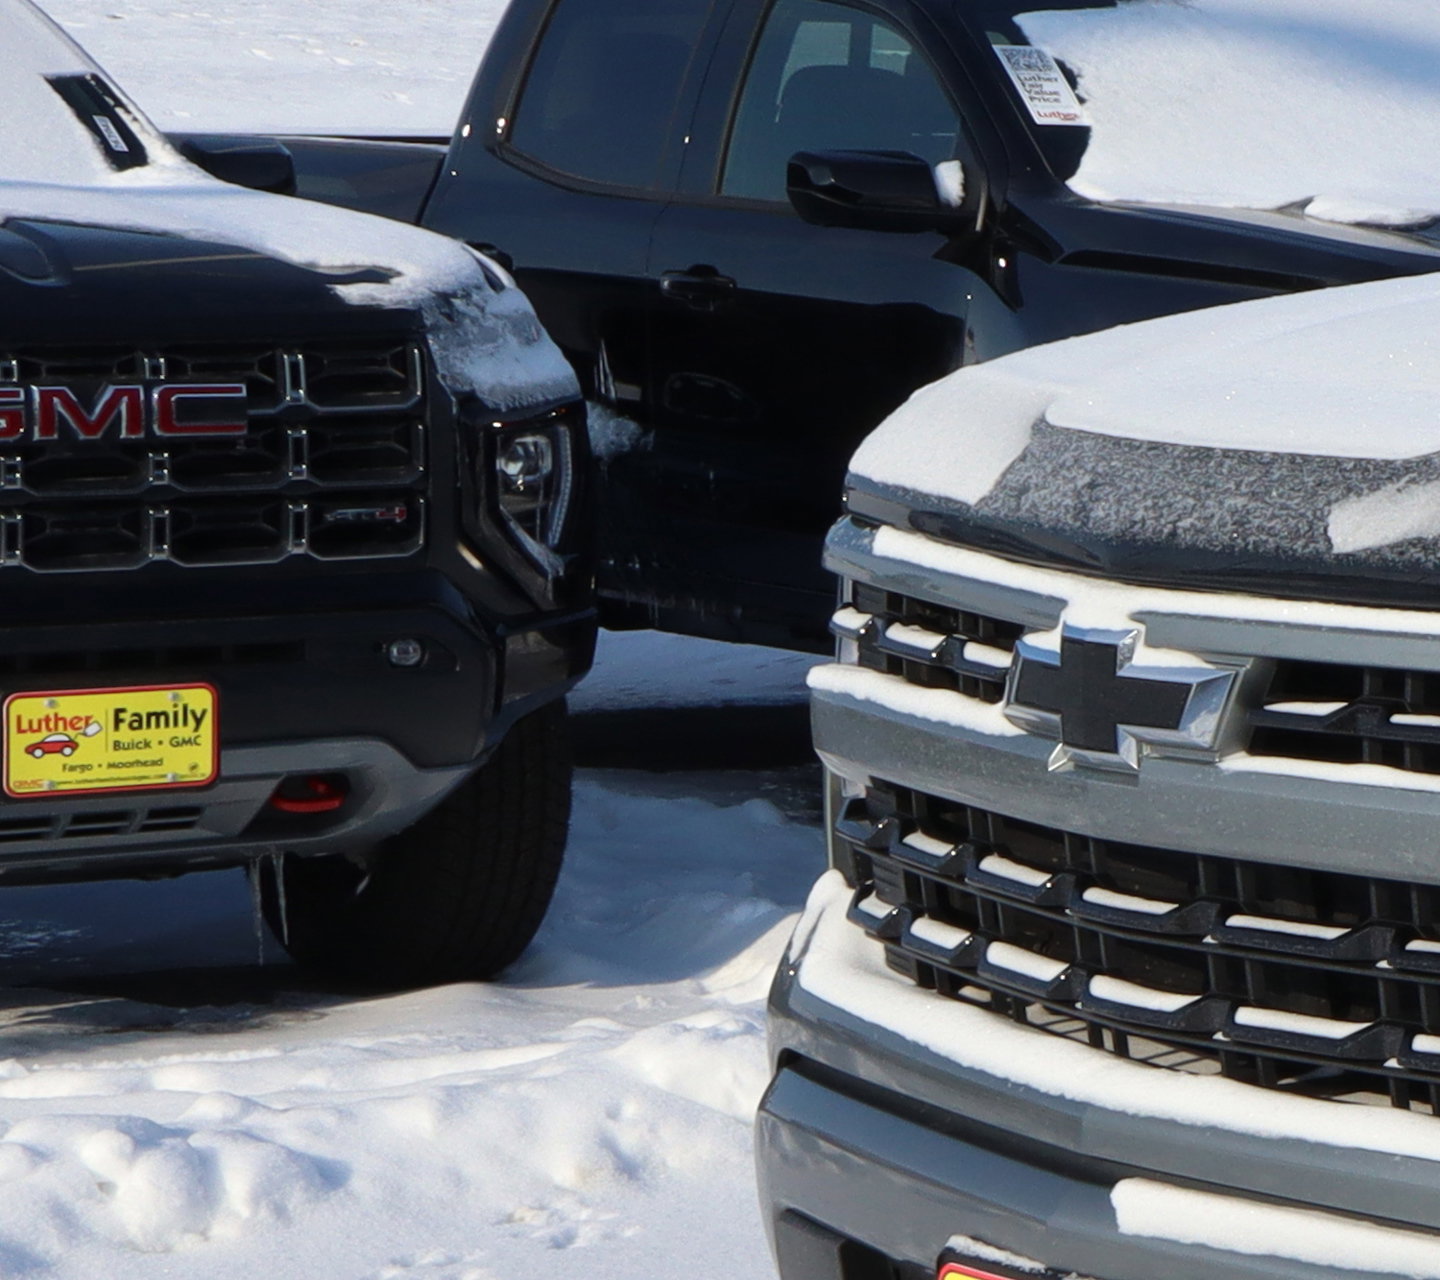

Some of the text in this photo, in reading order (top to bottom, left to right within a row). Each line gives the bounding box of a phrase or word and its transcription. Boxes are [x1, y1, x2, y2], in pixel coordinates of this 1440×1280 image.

[0, 384, 247, 442] MC
[16, 703, 207, 734] Luther Family
[113, 735, 201, 751] Buick GMC
[62, 758, 164, 773] Fargo Moorhead
